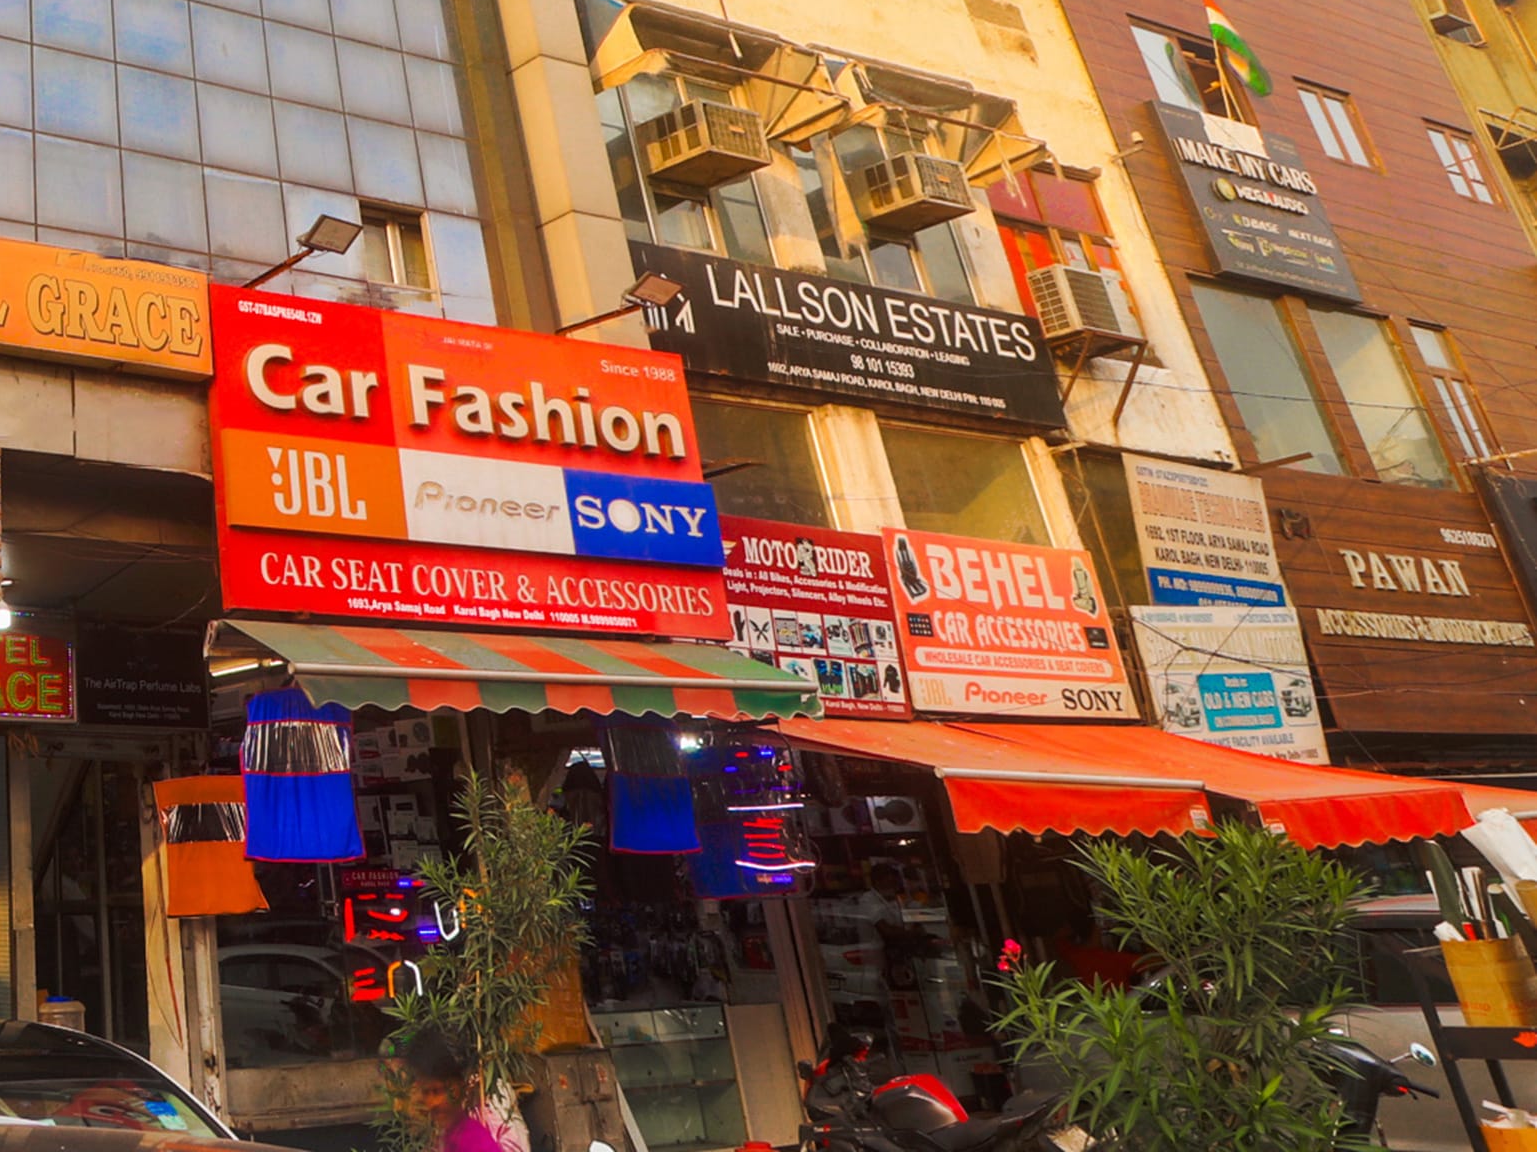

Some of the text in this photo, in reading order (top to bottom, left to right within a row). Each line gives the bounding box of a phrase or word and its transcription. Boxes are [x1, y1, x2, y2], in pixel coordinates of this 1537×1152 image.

[1175, 136, 1239, 175] MAKE
[1237, 152, 1267, 181] MY
[1266, 161, 1319, 196] CARS
[25, 272, 203, 357] GRACE
[705, 263, 1038, 363] LALLSON ESTATES
[776, 323, 971, 367] SALE PURCHASE COLLABORATION LEASING
[850, 354, 865, 370] 98
[866, 356, 884, 374] 101
[601, 358, 677, 383] Since 1988
[790, 364, 812, 379] ARYA
[812, 368, 841, 385] SAMAJ
[868, 377, 894, 392] KAROL
[921, 385, 940, 399] NEW
[245, 344, 687, 460] Car Fashion
[269, 447, 708, 539] JBL Pioneer SONY
[741, 535, 874, 579] MOTO RIDER
[924, 543, 1065, 611] BEHEL
[1338, 548, 1472, 598] PAWAN
[260, 551, 715, 619] CAR SEAT COVER & ACCESSORIES
[394, 599, 423, 617] Samaj
[423, 603, 446, 616] Road
[453, 604, 477, 618] Karol
[478, 606, 501, 622] Bagh
[502, 608, 522, 620] New
[523, 609, 546, 622] Delhi
[932, 609, 1087, 653] CAR ACCESSORIES
[924, 651, 974, 666] WHOLESALE
[974, 653, 992, 667] CAR
[993, 655, 1047, 671] ACCESSORIES
[1055, 659, 1076, 673] SEAT
[1077, 661, 1106, 675] COVERS
[83, 677, 102, 689] The
[139, 680, 178, 693] Perfume
[179, 681, 202, 694] Labs
[965, 681, 1048, 706] Pioneer
[1061, 688, 1123, 712] SONY
